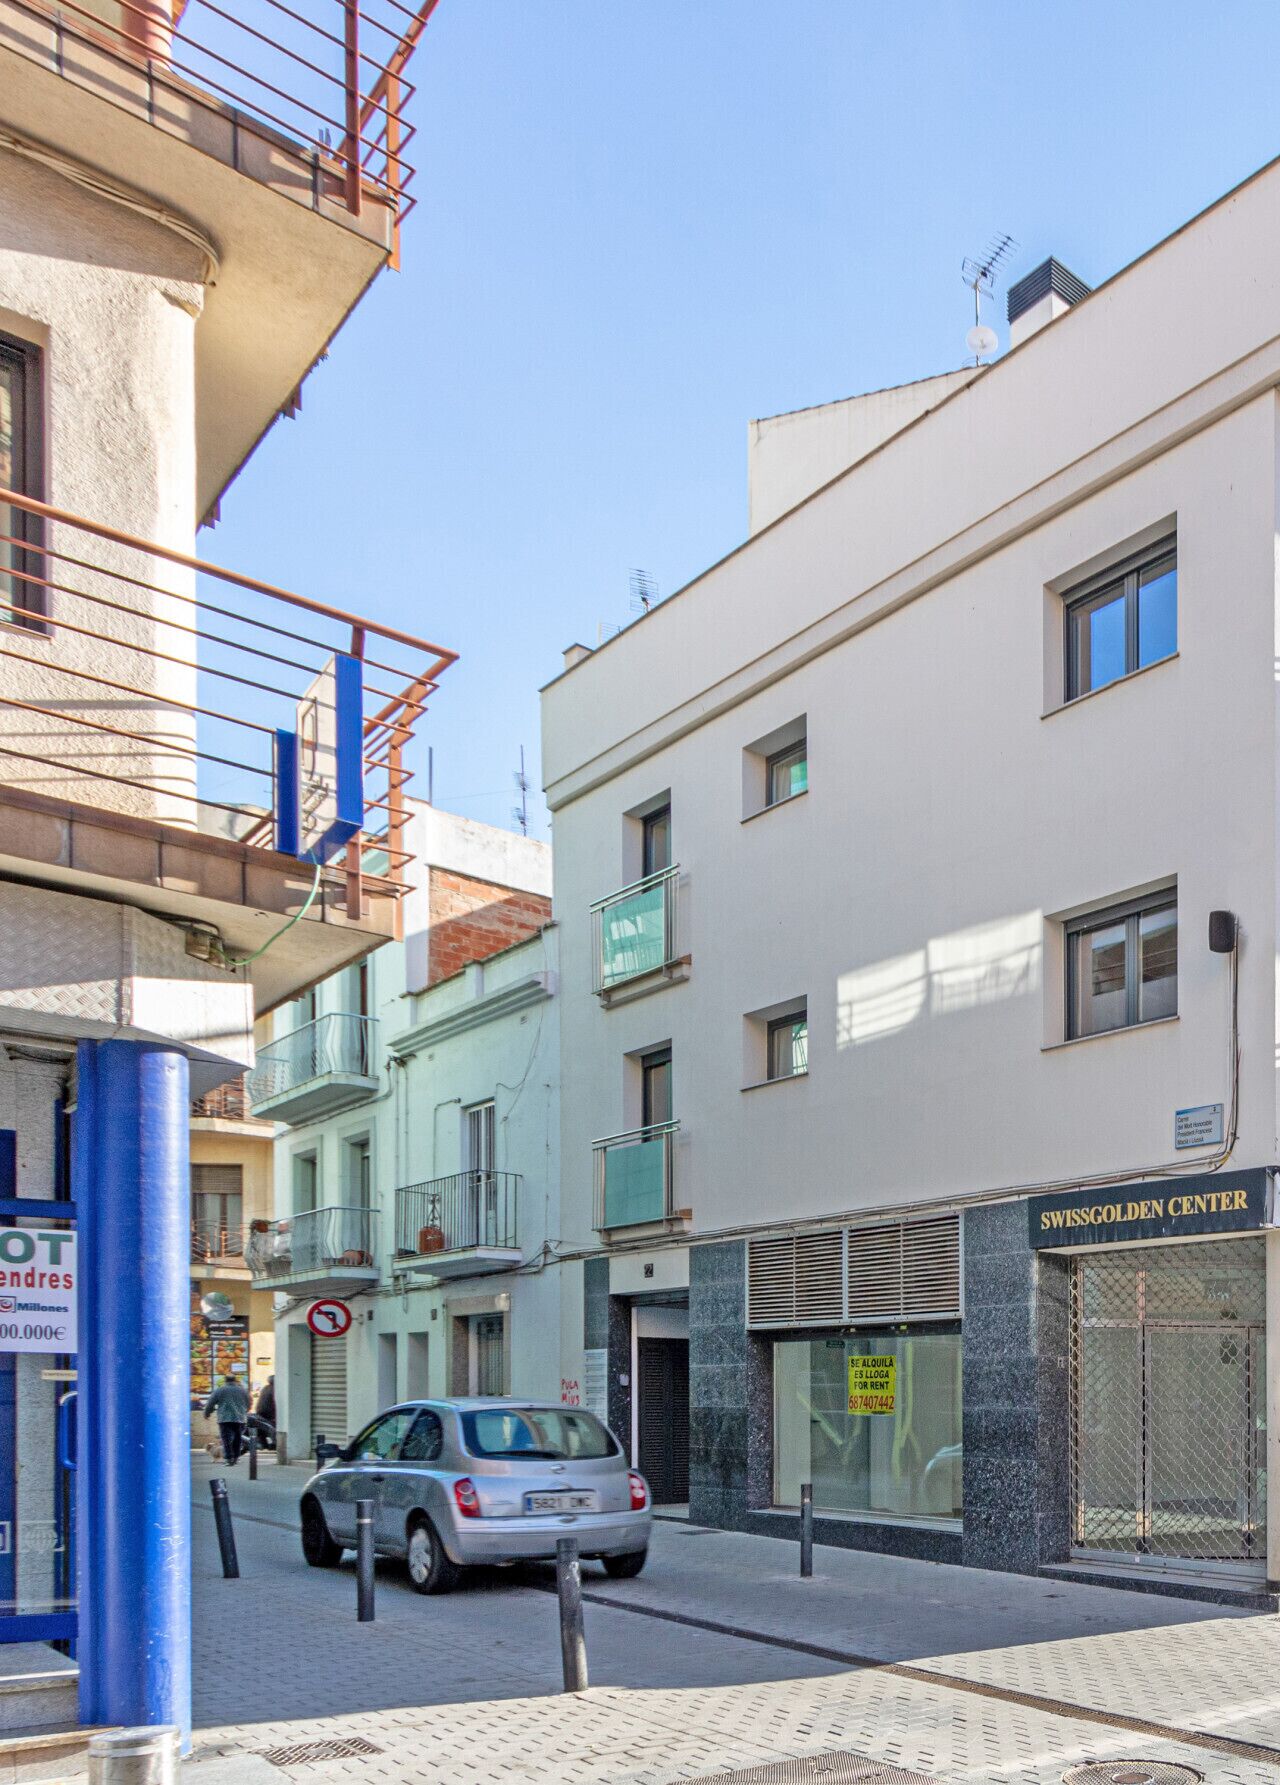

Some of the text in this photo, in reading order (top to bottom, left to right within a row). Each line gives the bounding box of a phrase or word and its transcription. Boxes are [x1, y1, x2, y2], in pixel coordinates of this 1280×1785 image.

[1041, 1189, 1248, 1230] SWISSGOLDEN CENTER
[17, 1302, 69, 1313] Millones
[850, 1358, 860, 1368] SE
[854, 1370, 890, 1379] ES LLOGA
[854, 1381, 890, 1391] FOR RENT
[848, 1395, 895, 1410] 687407442
